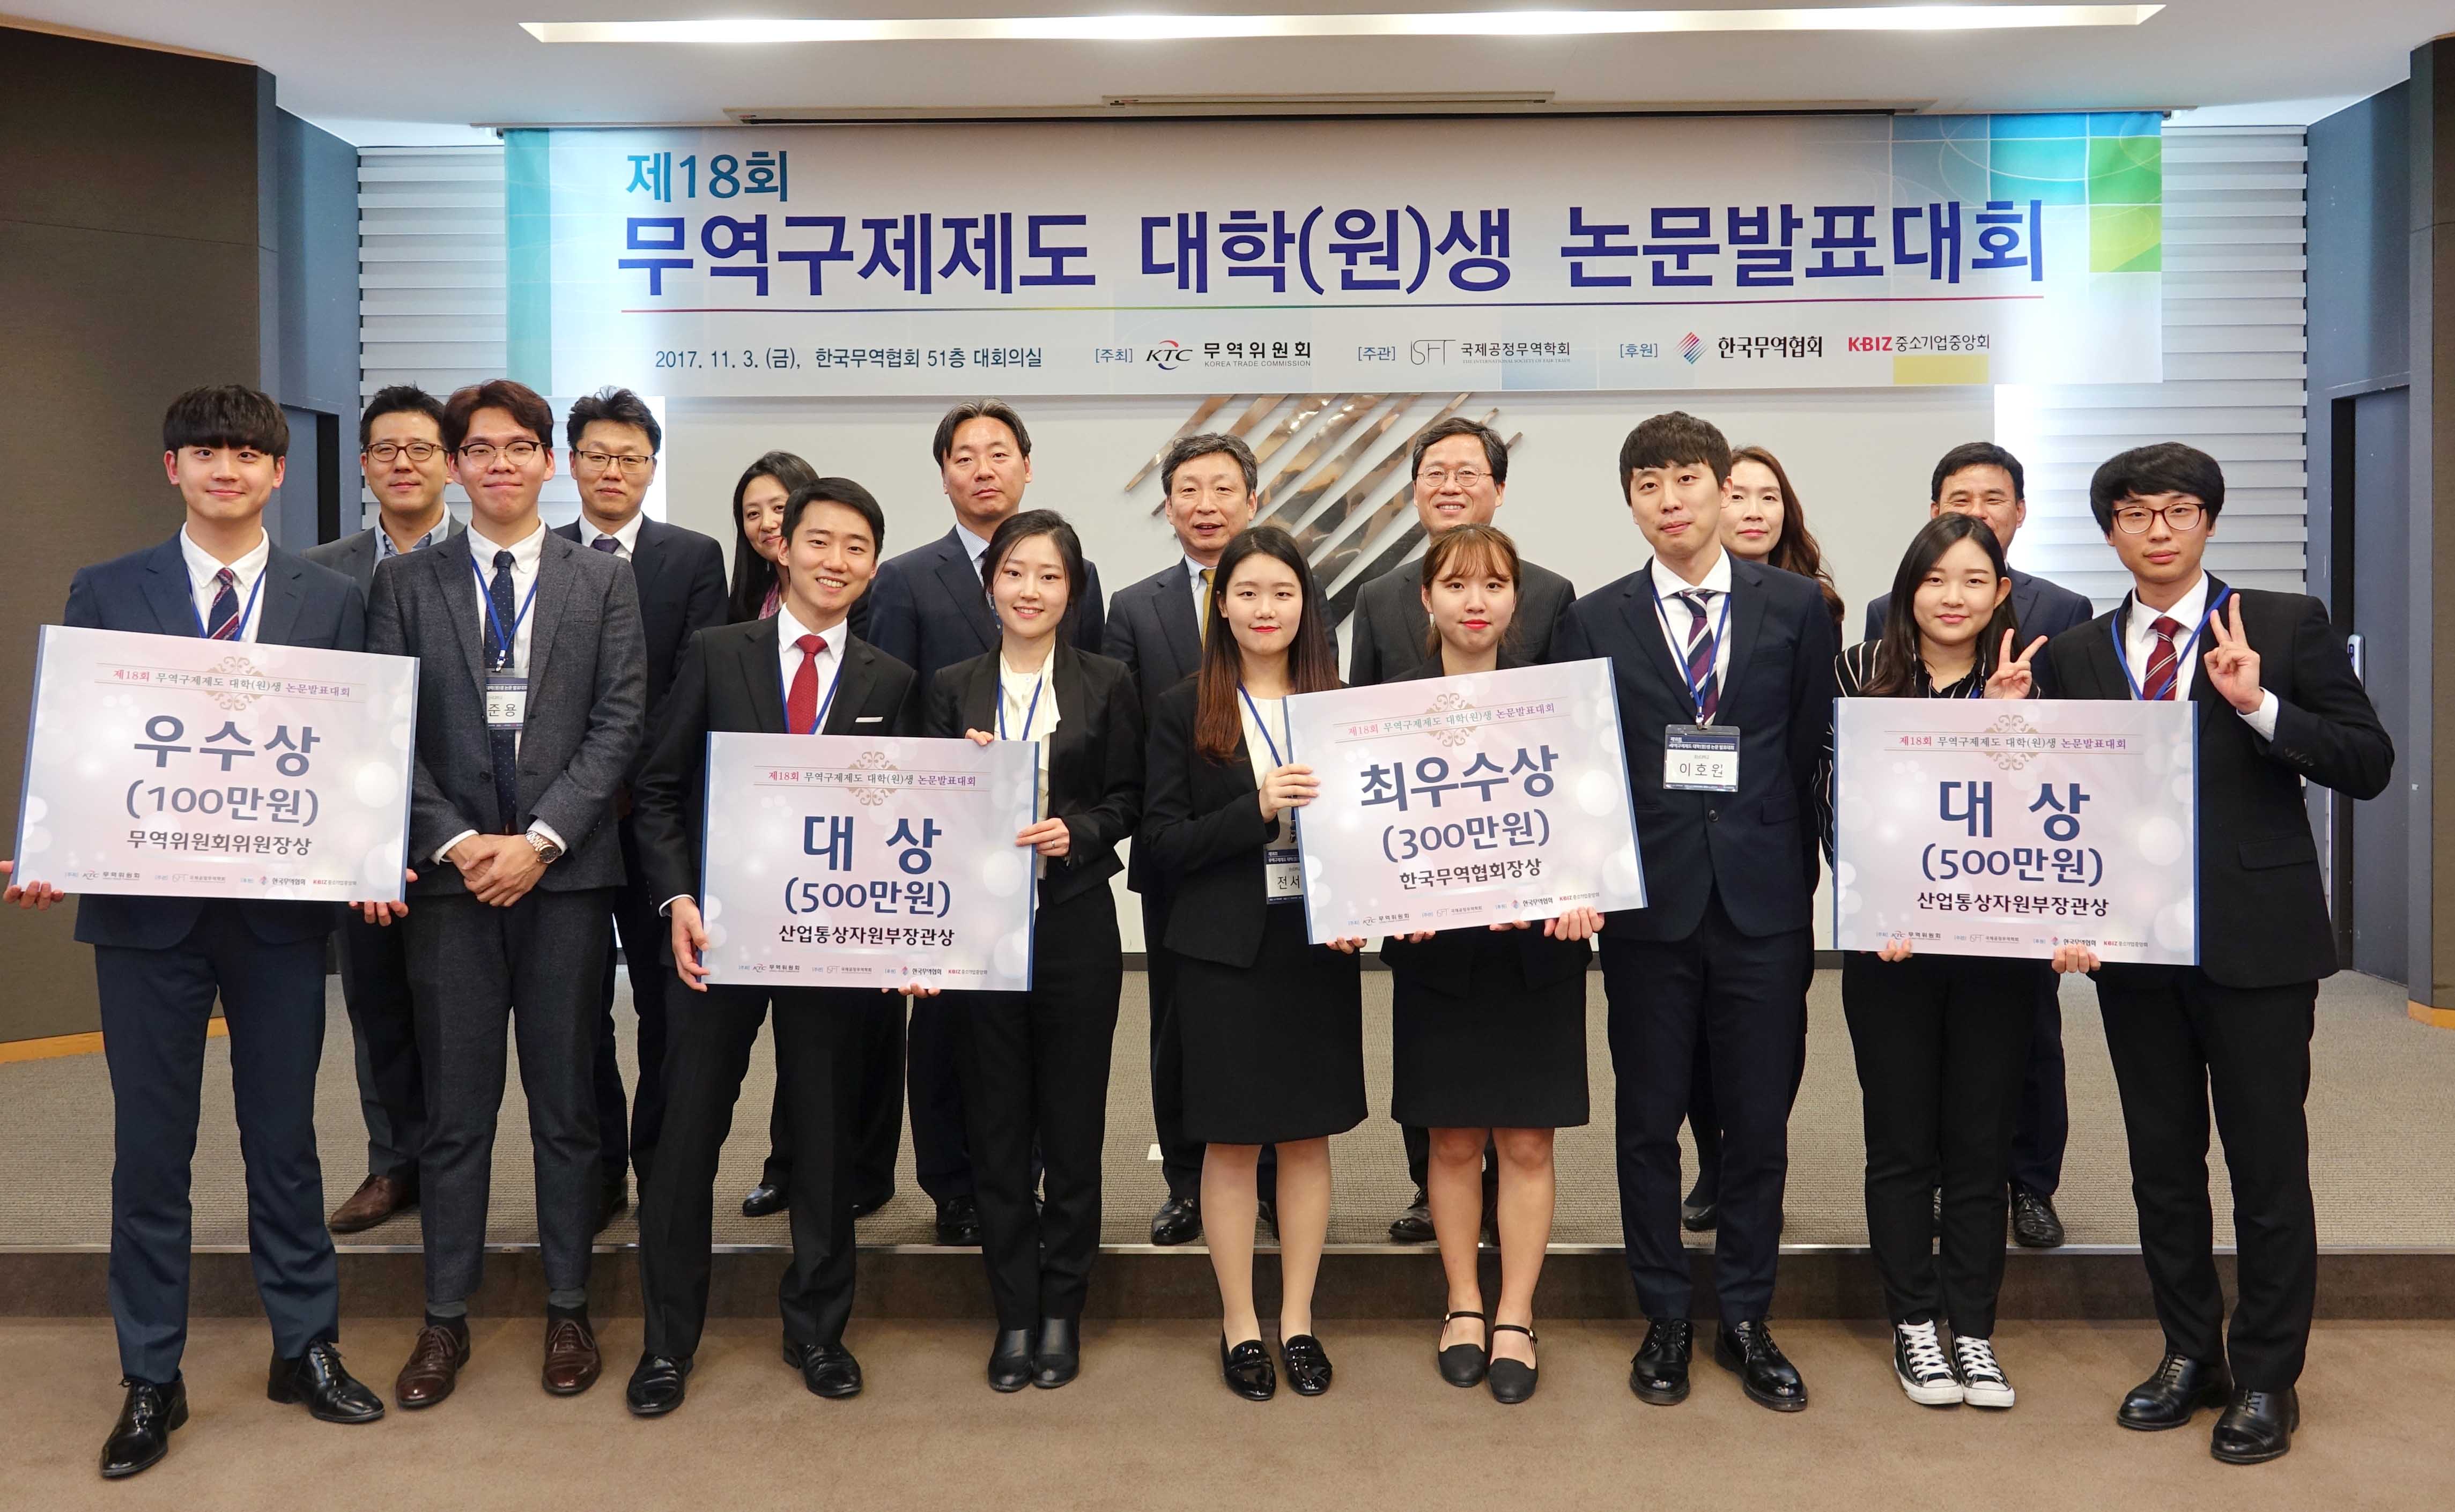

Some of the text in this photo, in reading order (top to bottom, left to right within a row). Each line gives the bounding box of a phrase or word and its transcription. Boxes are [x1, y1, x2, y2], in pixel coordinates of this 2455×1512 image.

[626, 150, 788, 202] 제18회
[618, 199, 2044, 297] 무역구제제도 대학(원)생 논문발표대회
[1204, 342, 1311, 359] 무역위원회
[1358, 346, 1396, 361] [주관]
[1460, 342, 1571, 357] 국제공정무역학회
[1620, 343, 1659, 358] [후원]
[1718, 336, 1823, 359] 한국무역협회
[1848, 334, 1990, 352] KBIZ 중소기업중앙회
[656, 347, 1042, 370] 2017. 11. 3. (금), 한국무역협회 51층 대회의실
[1096, 348, 1133, 364] [주최]
[1146, 349, 1193, 362] KTC
[113, 669, 351, 697] 제18회 무역구제제도 대학(원)생 논문발표대회
[488, 703, 516, 717] 준용
[1348, 702, 1555, 737] 제18회 무역구제제도 대학(원)생 논문발표대회
[134, 715, 321, 777] 우수상
[1899, 735, 2127, 750] 제18회 무역구제제도 대학(원)생 논문발표대회
[768, 771, 976, 787] 제18회 무역구제제도 대학(원)생 논문발표대회
[1360, 745, 1558, 812] 최우수상
[126, 780, 319, 827] (100만원)
[127, 829, 312, 855] 무역위원회위원장상
[1383, 809, 1550, 863] (300만원)
[1399, 858, 1542, 890] 한국무역협회장상
[1922, 842, 2103, 887] (500만원)
[785, 877, 951, 918] (500만원)
[1917, 892, 2109, 917] 산업통상자원부장관상
[779, 925, 955, 946] 산업통상자원부장관상
